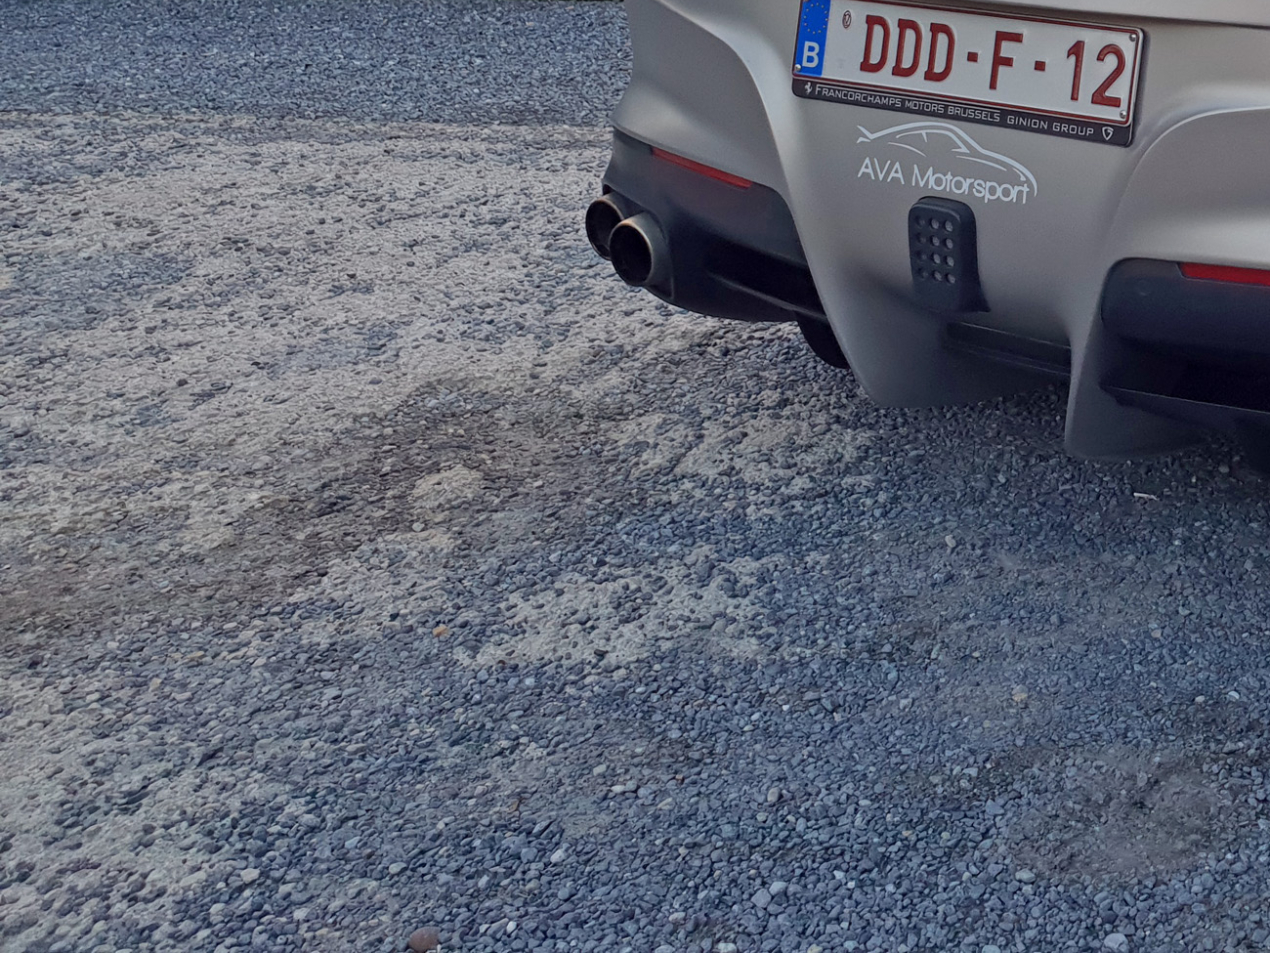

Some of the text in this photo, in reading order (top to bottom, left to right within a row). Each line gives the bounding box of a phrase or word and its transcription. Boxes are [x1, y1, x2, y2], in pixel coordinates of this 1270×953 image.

[801, 41, 820, 68] B
[815, 84, 1094, 137] FRANCORCHAMPS MOTORS BRUSSELS GINION GROUP
[858, 157, 1030, 204] AVA Motorsport
